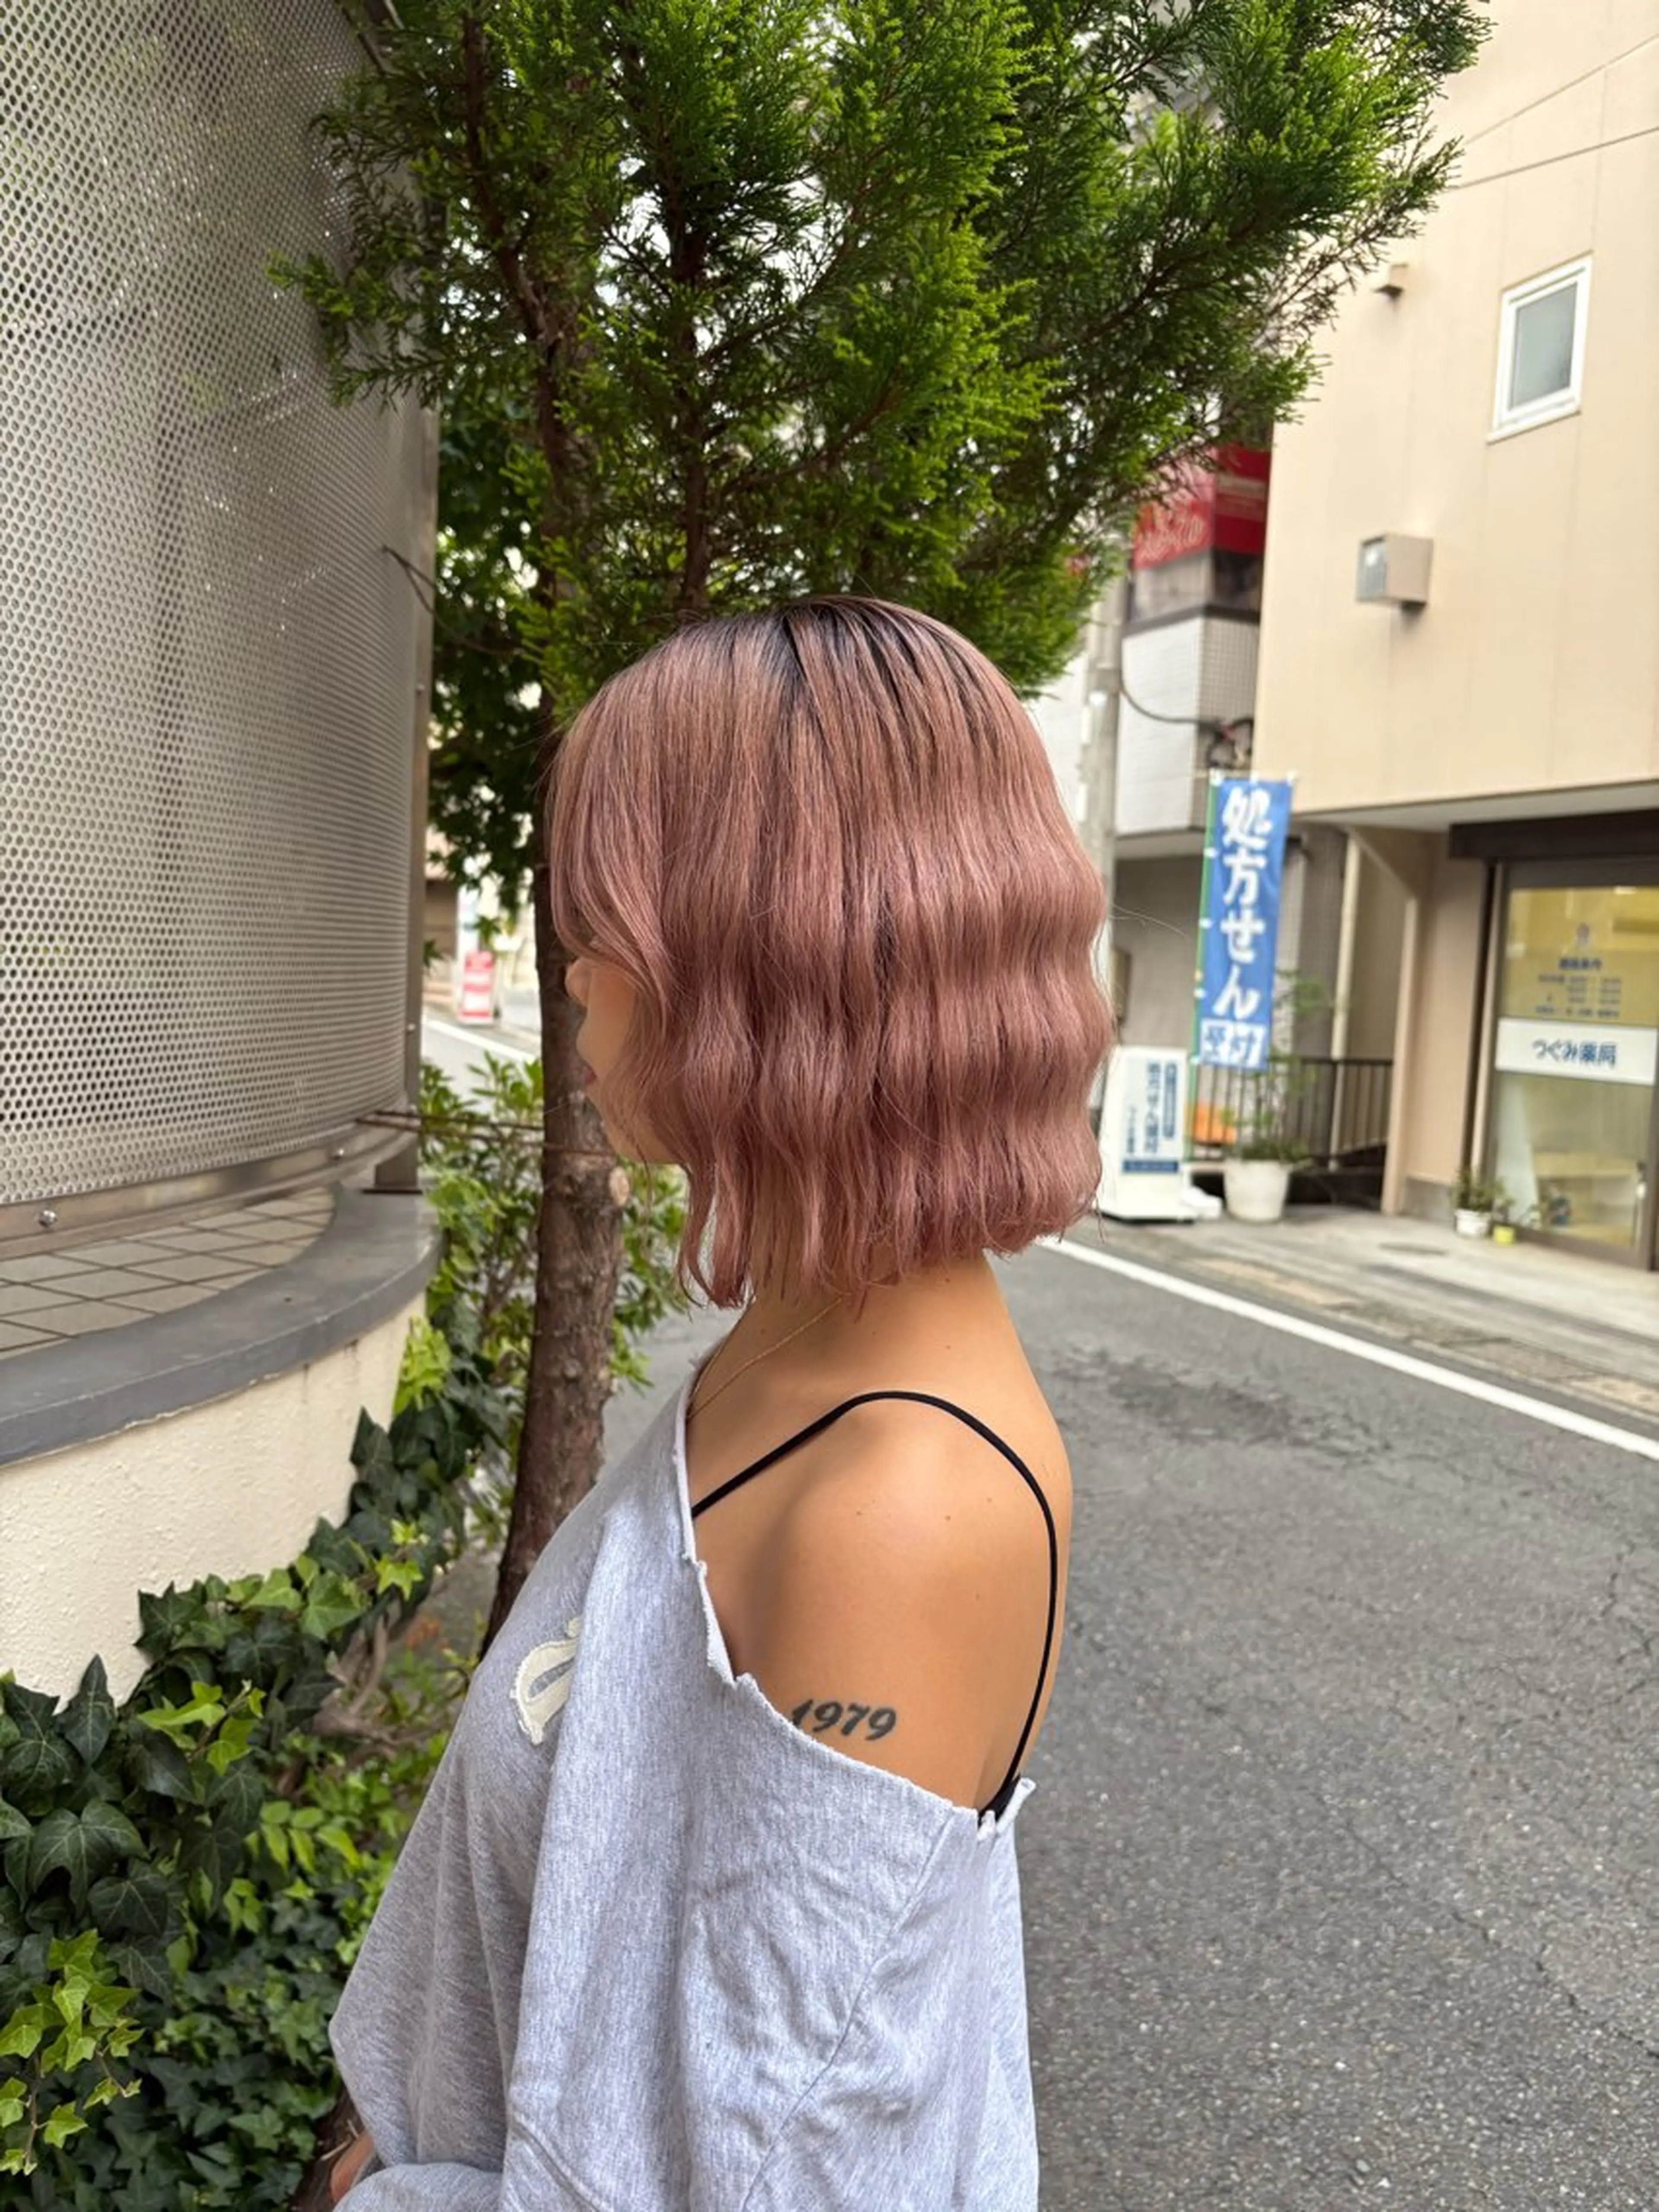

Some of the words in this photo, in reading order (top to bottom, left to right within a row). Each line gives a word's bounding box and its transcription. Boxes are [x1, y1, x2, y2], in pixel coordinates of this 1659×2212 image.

[1213, 787, 1272, 1019] 処方せん
[1532, 1038, 1617, 1069] つぐみ薬局
[791, 1699, 896, 1741] 1979
